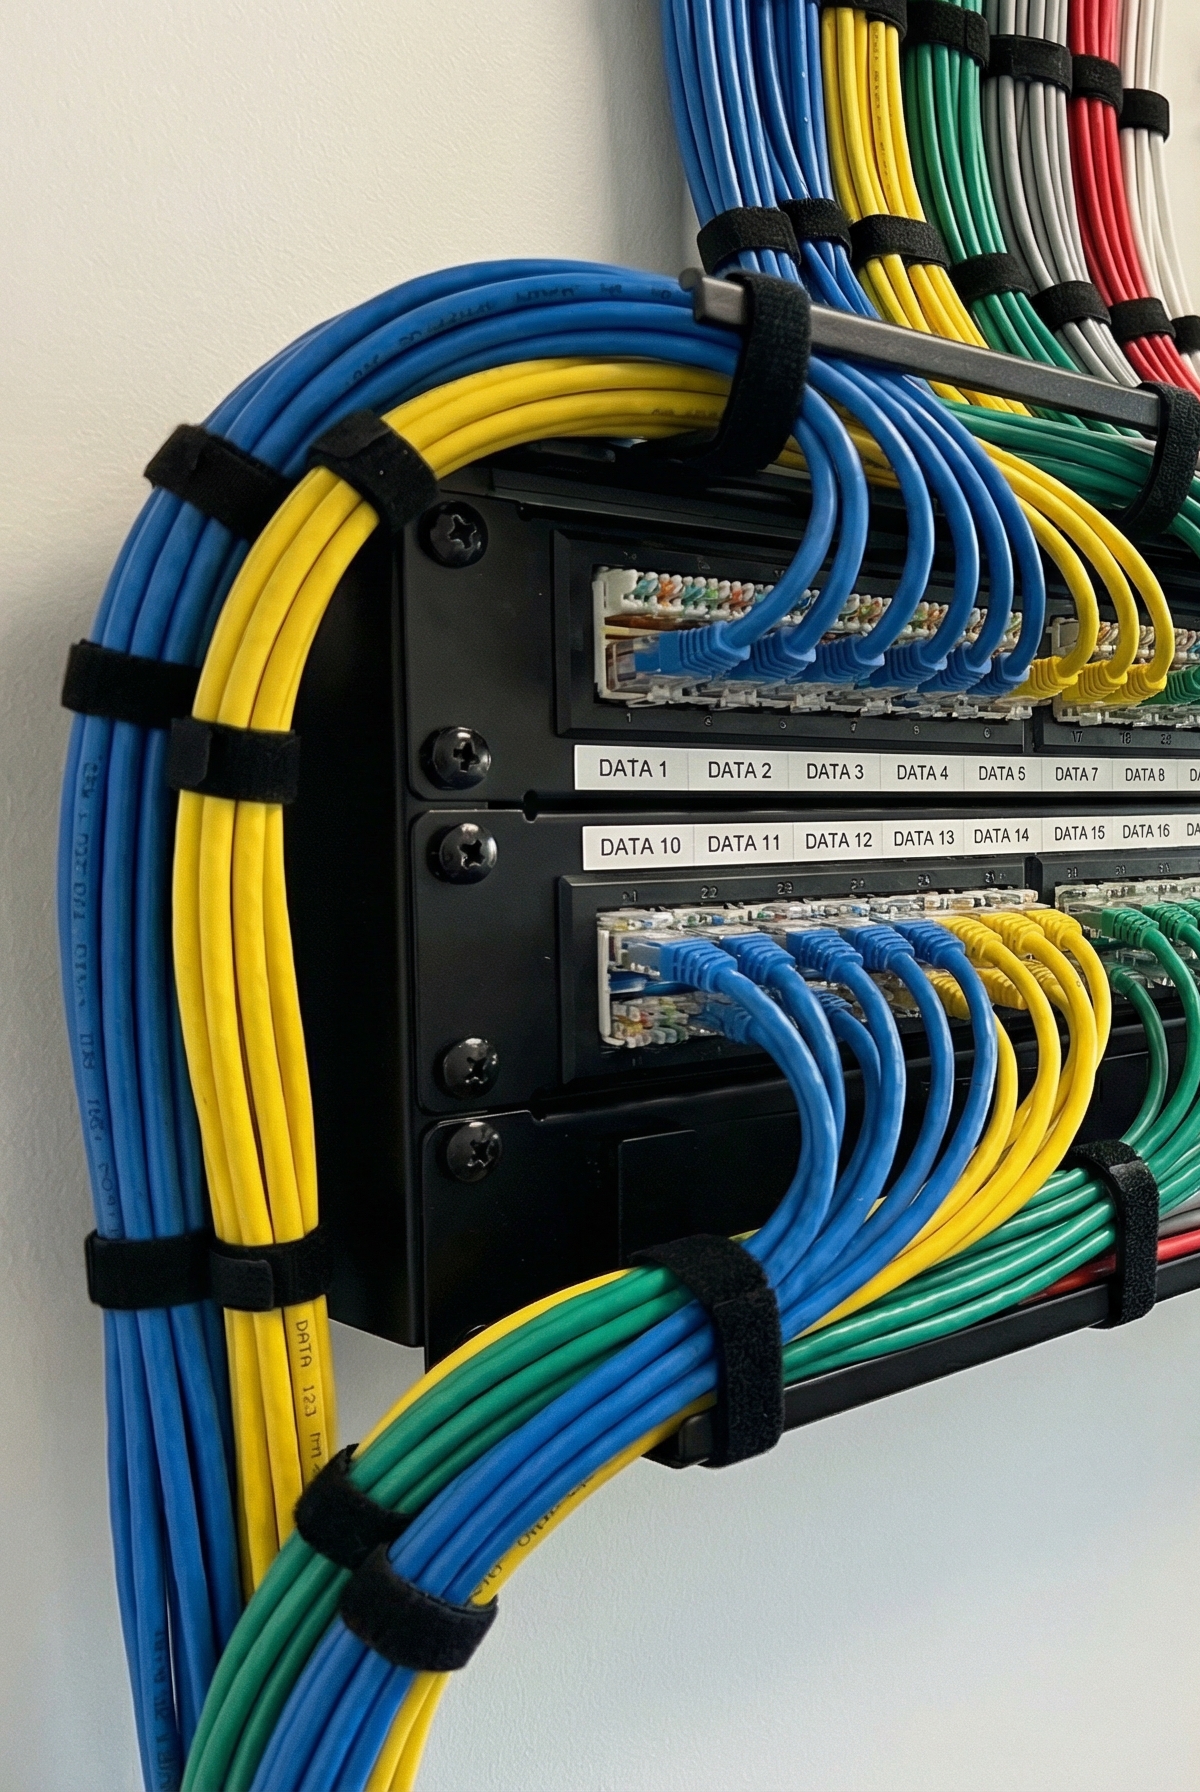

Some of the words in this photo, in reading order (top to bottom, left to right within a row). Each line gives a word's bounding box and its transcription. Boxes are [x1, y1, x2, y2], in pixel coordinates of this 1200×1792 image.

[599, 759, 652, 777] DATA
[659, 762, 667, 777] 1
[708, 761, 756, 779] DATA
[761, 762, 772, 779] 2
[806, 763, 850, 780] DATA
[853, 764, 864, 780] 3
[897, 765, 937, 780] DATA
[938, 766, 949, 780] 4
[979, 766, 1014, 780] DATA
[1017, 766, 1026, 780] 5
[1056, 767, 1088, 781] DATA
[1091, 768, 1098, 781] 7
[1126, 768, 1157, 781] DATA
[1159, 768, 1165, 781] 8
[894, 830, 934, 846] DATA
[938, 830, 954, 845] 13
[974, 829, 1010, 844] DATA
[1014, 828, 1029, 842] 14
[1055, 826, 1088, 841] DATA
[1091, 826, 1105, 839] 15
[1123, 825, 1154, 838] DATA
[1157, 824, 1170, 837] 16
[601, 838, 654, 856] DATA
[660, 838, 681, 854] 10
[708, 835, 756, 852] DATA
[762, 834, 780, 851] 11
[806, 833, 850, 849] DATA
[854, 832, 872, 848] 12
[701, 886, 718, 898] 22
[296, 1319, 312, 1367] DATA
